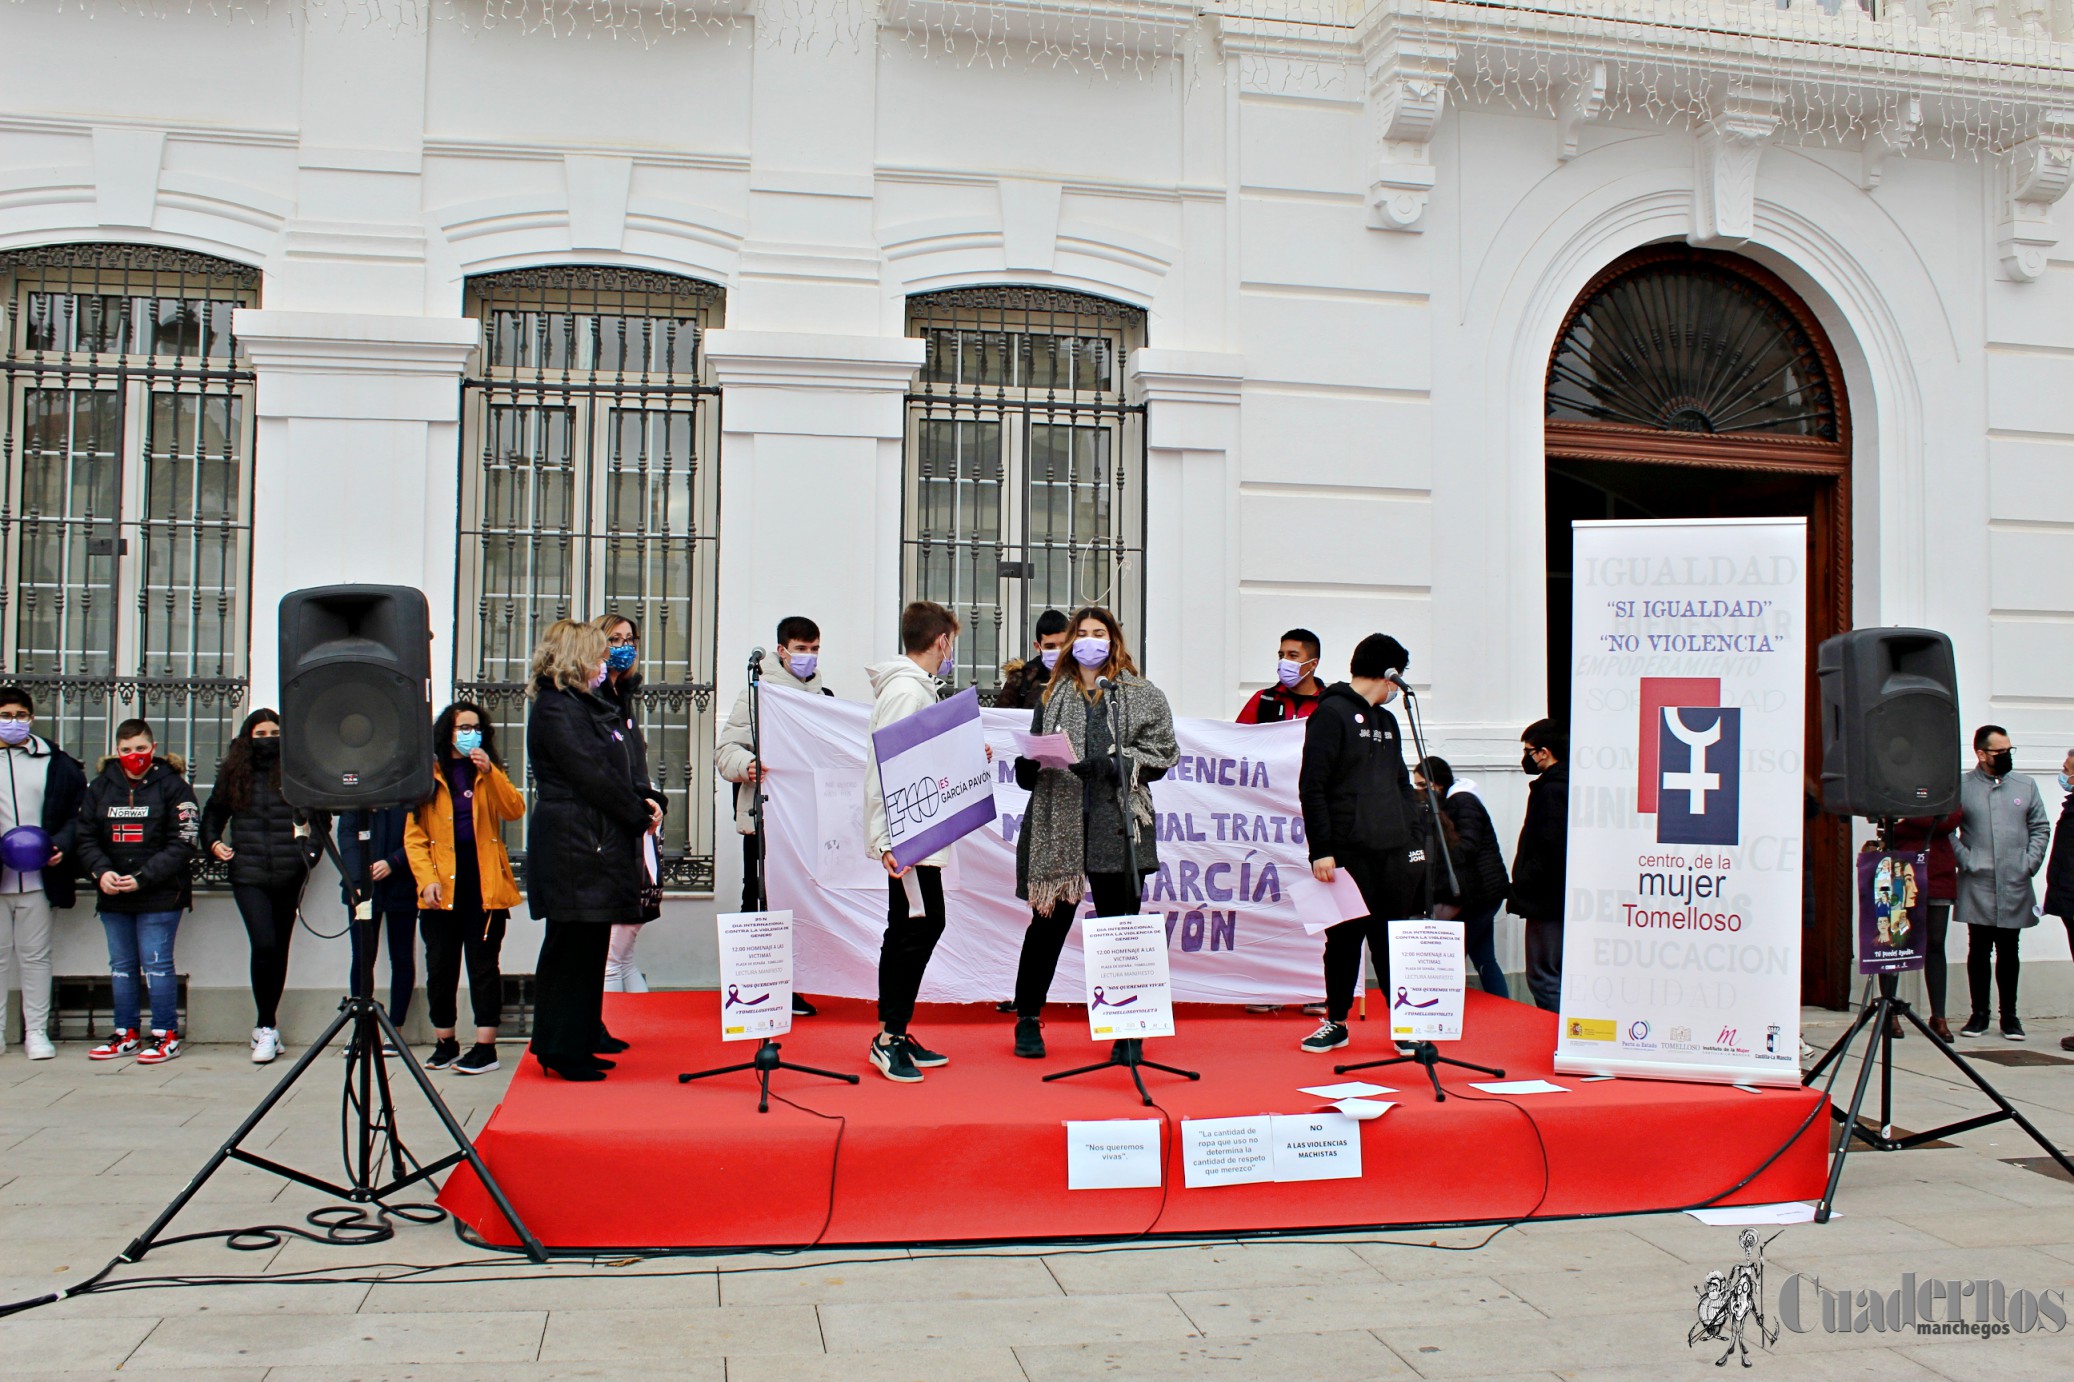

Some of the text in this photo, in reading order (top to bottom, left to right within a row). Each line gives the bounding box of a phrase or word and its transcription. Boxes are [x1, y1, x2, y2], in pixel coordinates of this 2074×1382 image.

[1585, 555, 1798, 587] IGUALDAD
[938, 777, 949, 790] IES
[941, 781, 968, 803] GARCÍA
[1638, 854, 1731, 870] centro de la
[1639, 866, 1726, 905] mujer
[1622, 904, 1742, 932] Tomelloso
[1593, 937, 1790, 974] EDUCACION
[1568, 974, 1737, 1009] EQUIDAD
[1661, 1042, 1701, 1051] TOMELLOSO
[1213, 1128, 1245, 1137] cantidad
[1106, 1144, 1144, 1152] queremos
[1198, 1140, 1216, 1148] ropa
[1217, 1139, 1232, 1147] que
[1307, 1140, 1348, 1148] VIOLENCIAS
[1206, 1147, 1243, 1156] determina
[1298, 1150, 1338, 1158] MACHISTAS
[1193, 1157, 1225, 1166] cantidad
[1238, 1155, 1266, 1163] respeto
[1205, 1168, 1219, 1176] que
